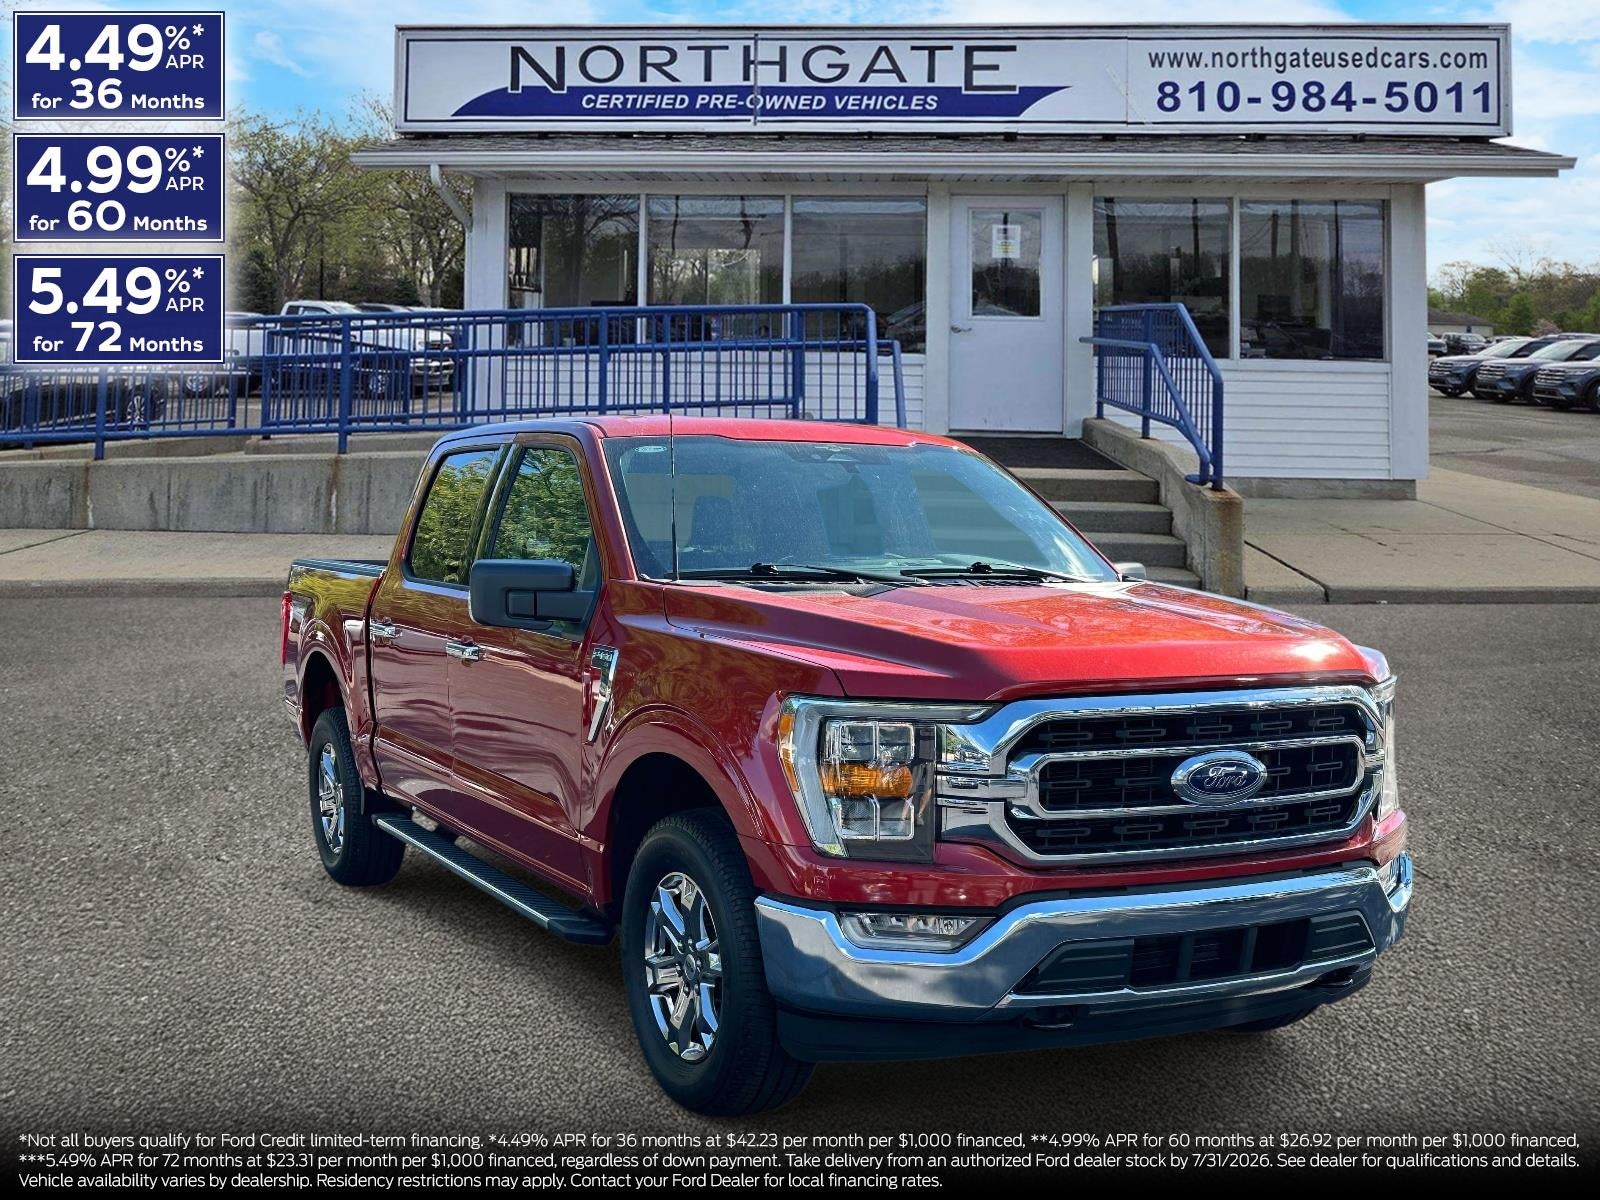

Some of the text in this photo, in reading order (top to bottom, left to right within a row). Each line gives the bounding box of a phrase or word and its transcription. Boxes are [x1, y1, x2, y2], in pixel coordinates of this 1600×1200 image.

[511, 45, 1017, 92] NORTHGATE
[1149, 47, 1488, 73] www.northgateusedcars.com
[581, 94, 939, 110] CERTIFIED PRE-OWNED VEHICLES
[1156, 81, 1491, 113] 810-984-5011
[1204, 765, 1248, 789] Ford
